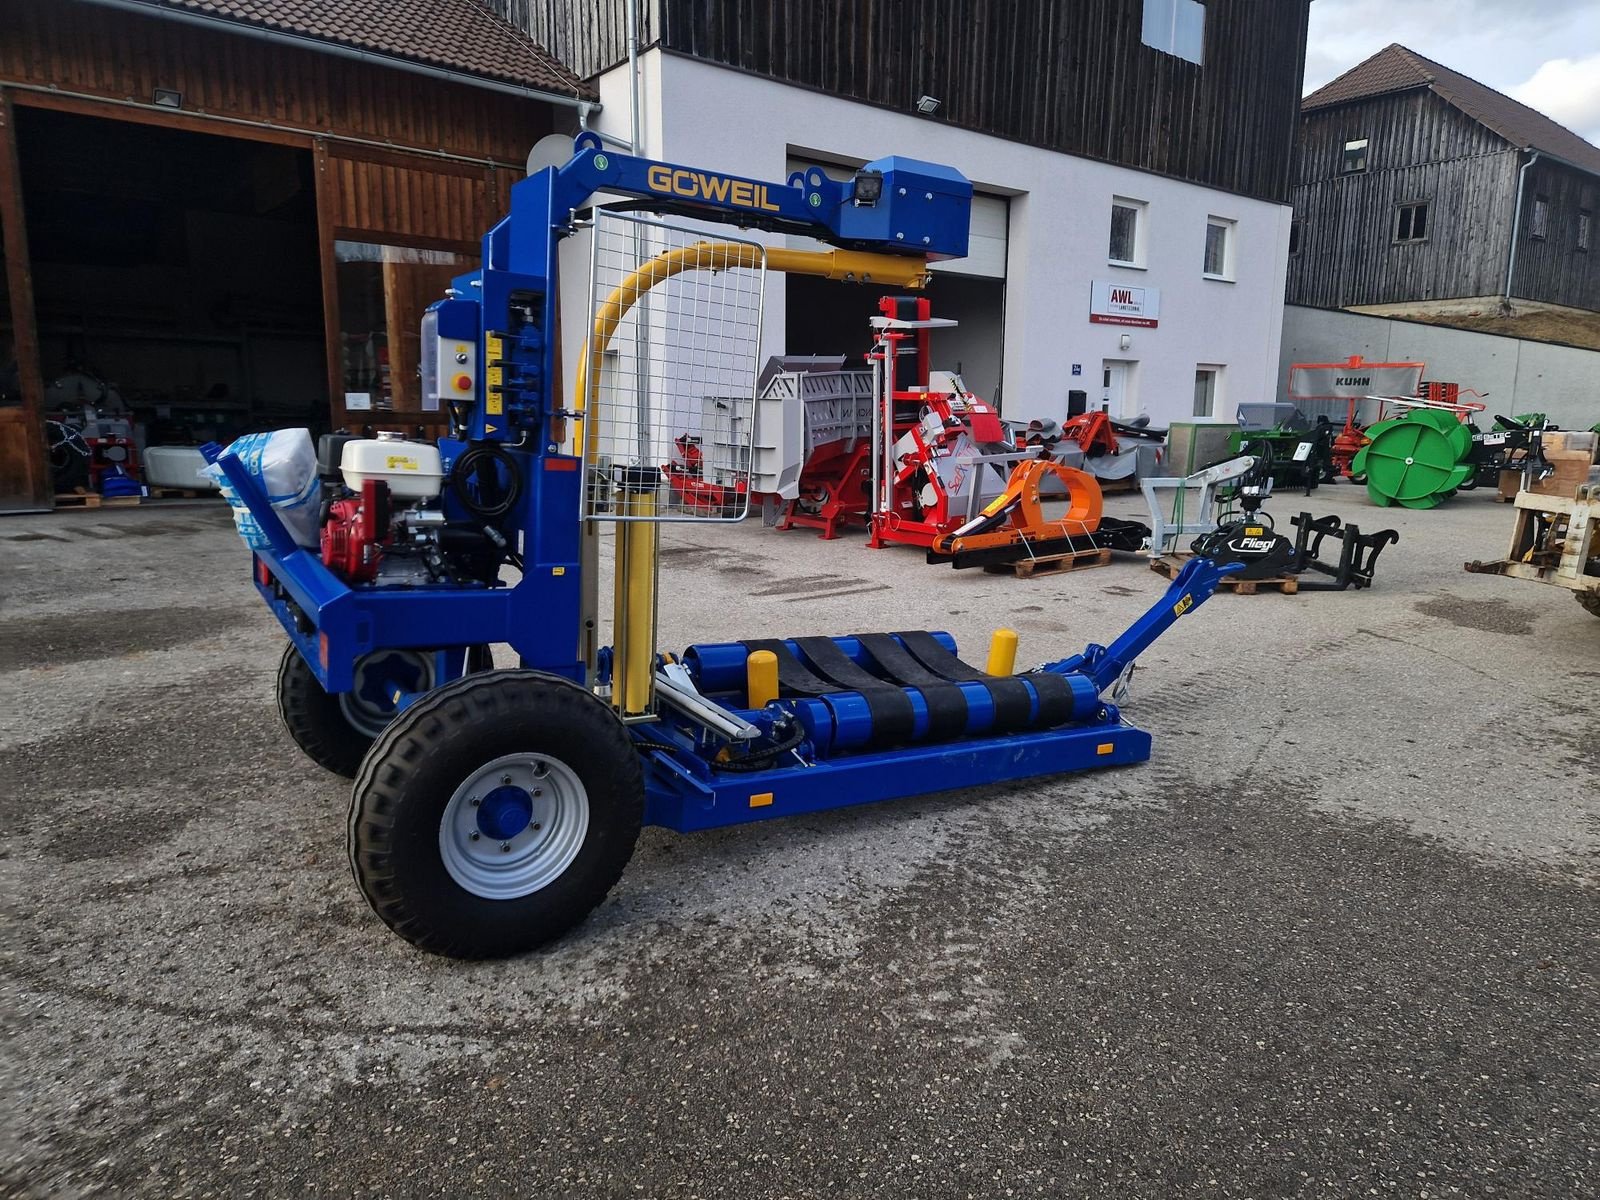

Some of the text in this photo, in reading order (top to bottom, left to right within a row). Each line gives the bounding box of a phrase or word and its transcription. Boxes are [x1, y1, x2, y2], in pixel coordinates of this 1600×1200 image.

[1111, 289, 1133, 304] AWL
[1336, 377, 1370, 386] KUHN
[1240, 538, 1276, 551] Fliegl
